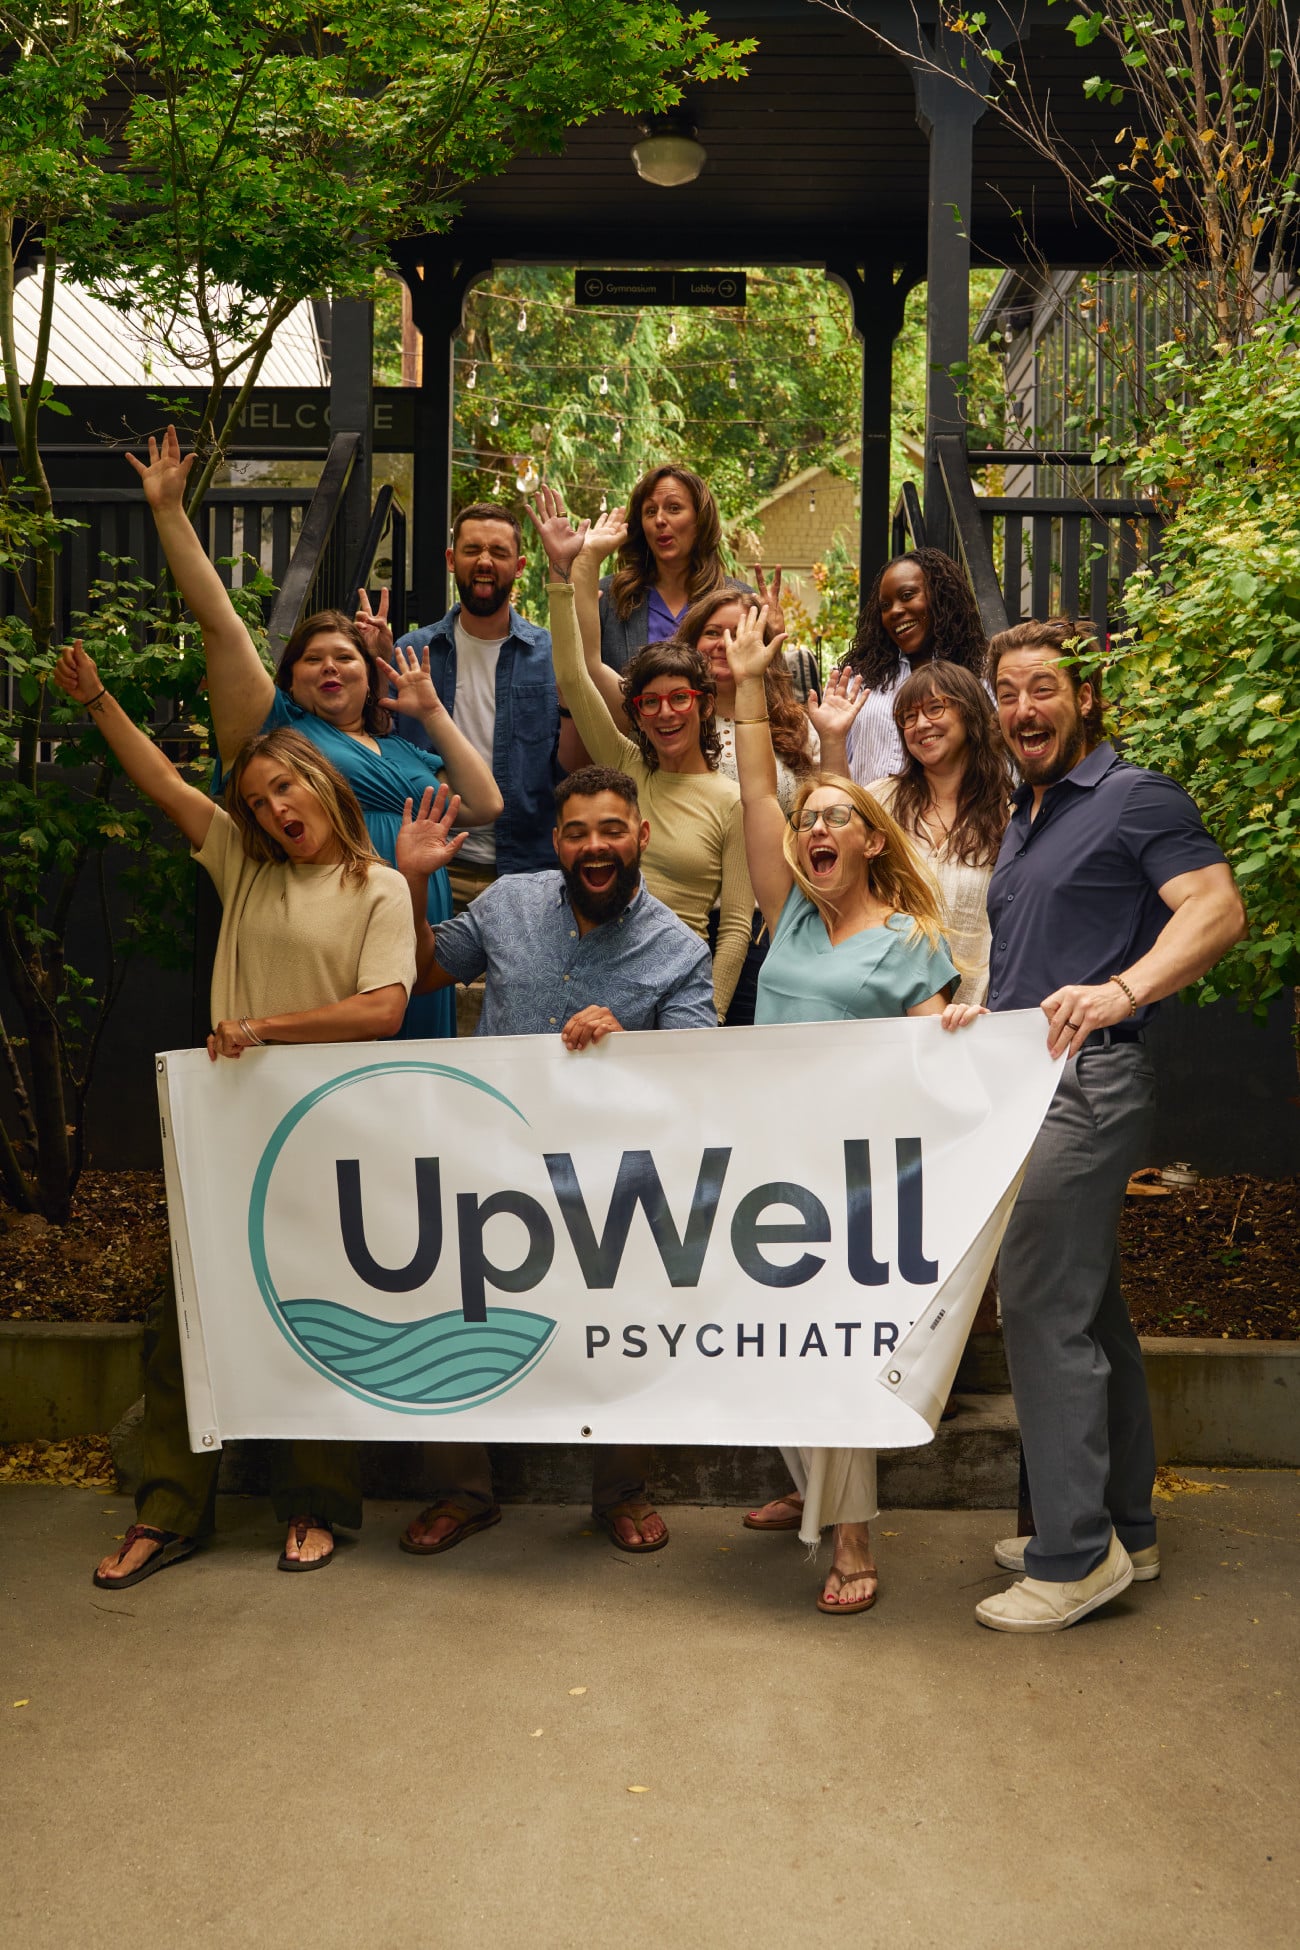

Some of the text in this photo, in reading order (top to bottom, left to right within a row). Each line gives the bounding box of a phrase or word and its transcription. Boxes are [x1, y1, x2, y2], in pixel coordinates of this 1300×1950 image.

[606, 283, 657, 293] Gymnasium
[690, 284, 716, 294] Lobby
[228, 403, 393, 430] ELCE
[335, 1136, 939, 1323] UpWell
[586, 1320, 914, 1359] PSYCHIATR
